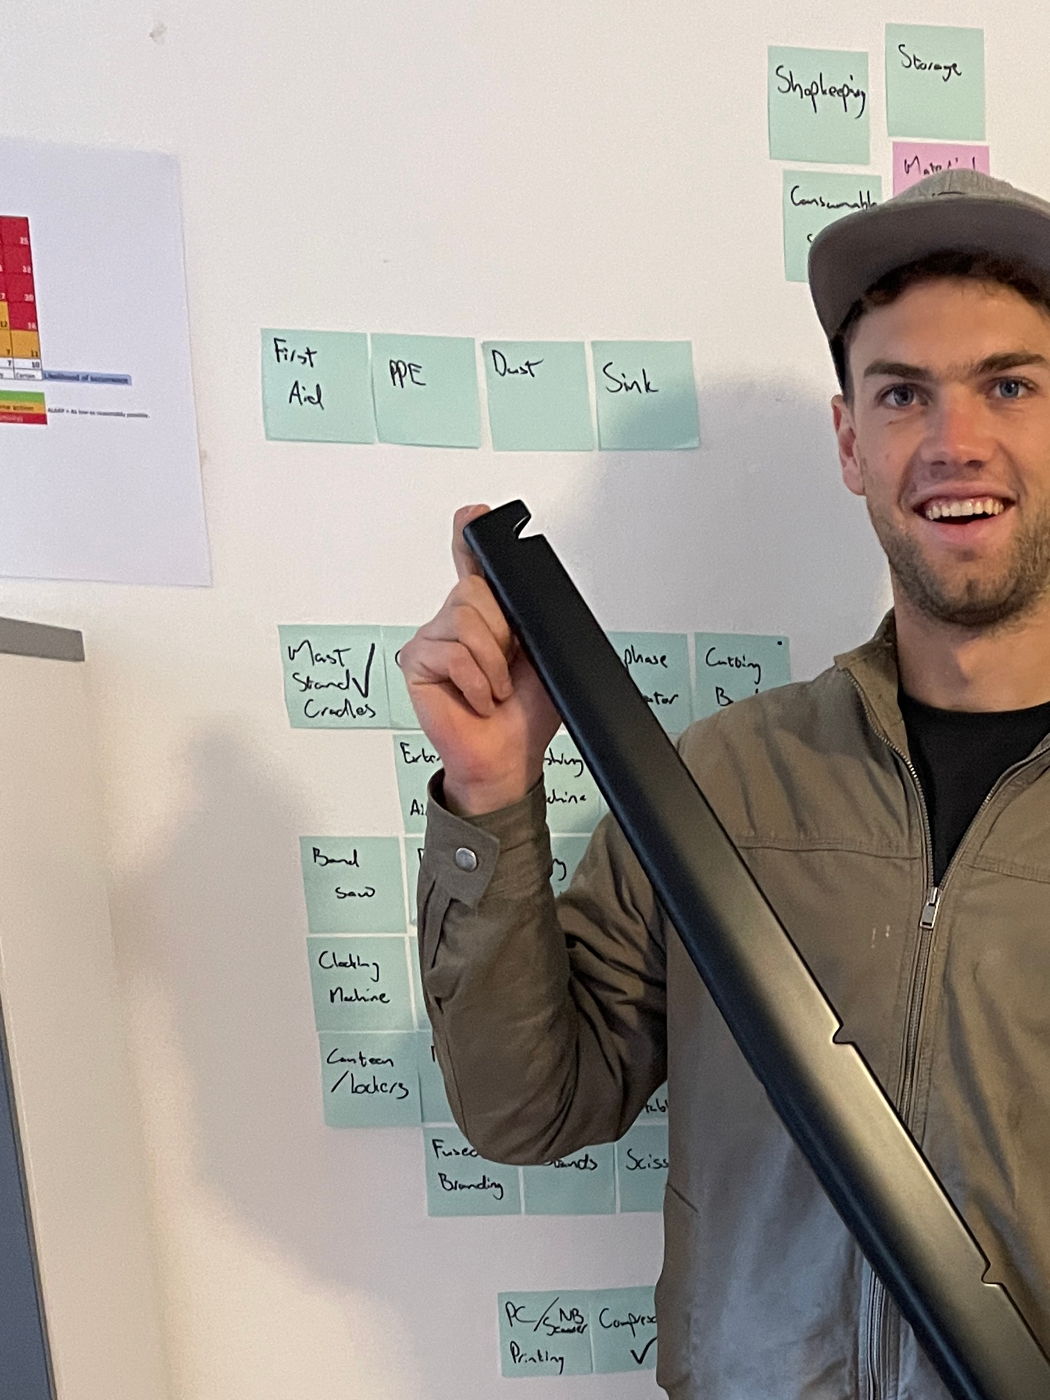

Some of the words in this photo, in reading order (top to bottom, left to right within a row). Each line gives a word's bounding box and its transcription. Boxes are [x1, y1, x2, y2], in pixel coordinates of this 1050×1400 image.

[898, 44, 962, 82] Storage
[273, 338, 318, 369] First
[491, 348, 545, 378] Dust
[389, 358, 427, 388] PPE
[602, 360, 660, 395] Sink
[288, 380, 325, 411] Aid
[288, 639, 352, 668] Mast
[705, 646, 761, 685] Cutting
[292, 668, 350, 693] Stand
[303, 698, 377, 720] Cradles
[546, 788, 588, 805] chine
[312, 846, 360, 869] Band
[329, 988, 392, 1005] Machine
[326, 1048, 395, 1068] Canteen
[438, 1171, 504, 1201] Branding
[509, 1340, 565, 1376] Printing
